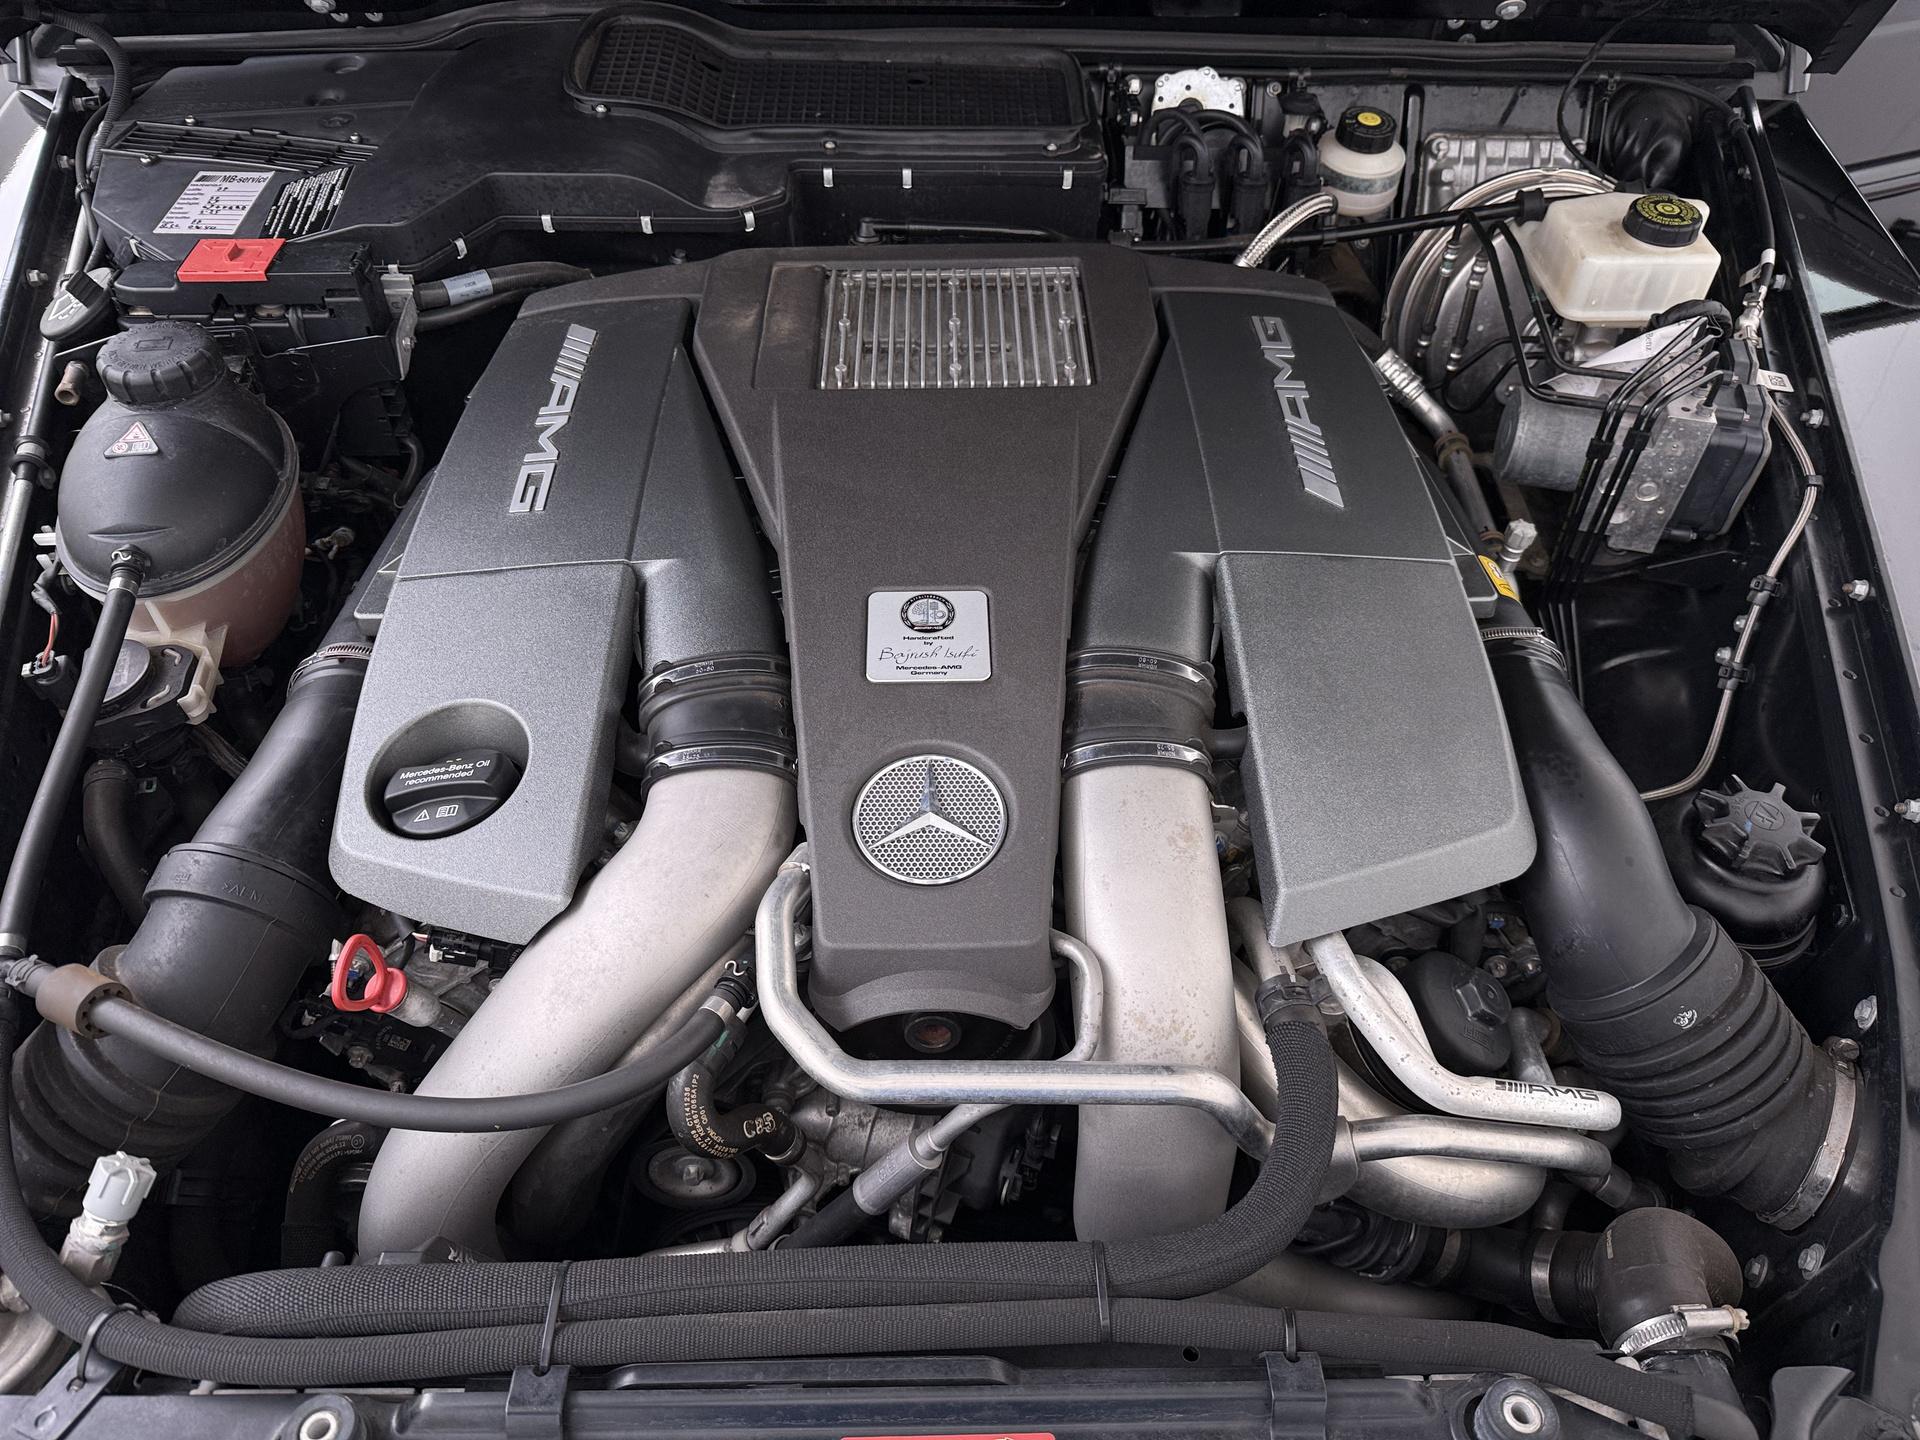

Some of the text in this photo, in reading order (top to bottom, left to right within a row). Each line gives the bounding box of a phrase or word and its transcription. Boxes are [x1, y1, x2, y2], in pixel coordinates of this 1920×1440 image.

[220, 174, 269, 183] MB-service
[400, 759, 491, 780] Mercedes-Benz Oil
[404, 770, 474, 786] recommended
